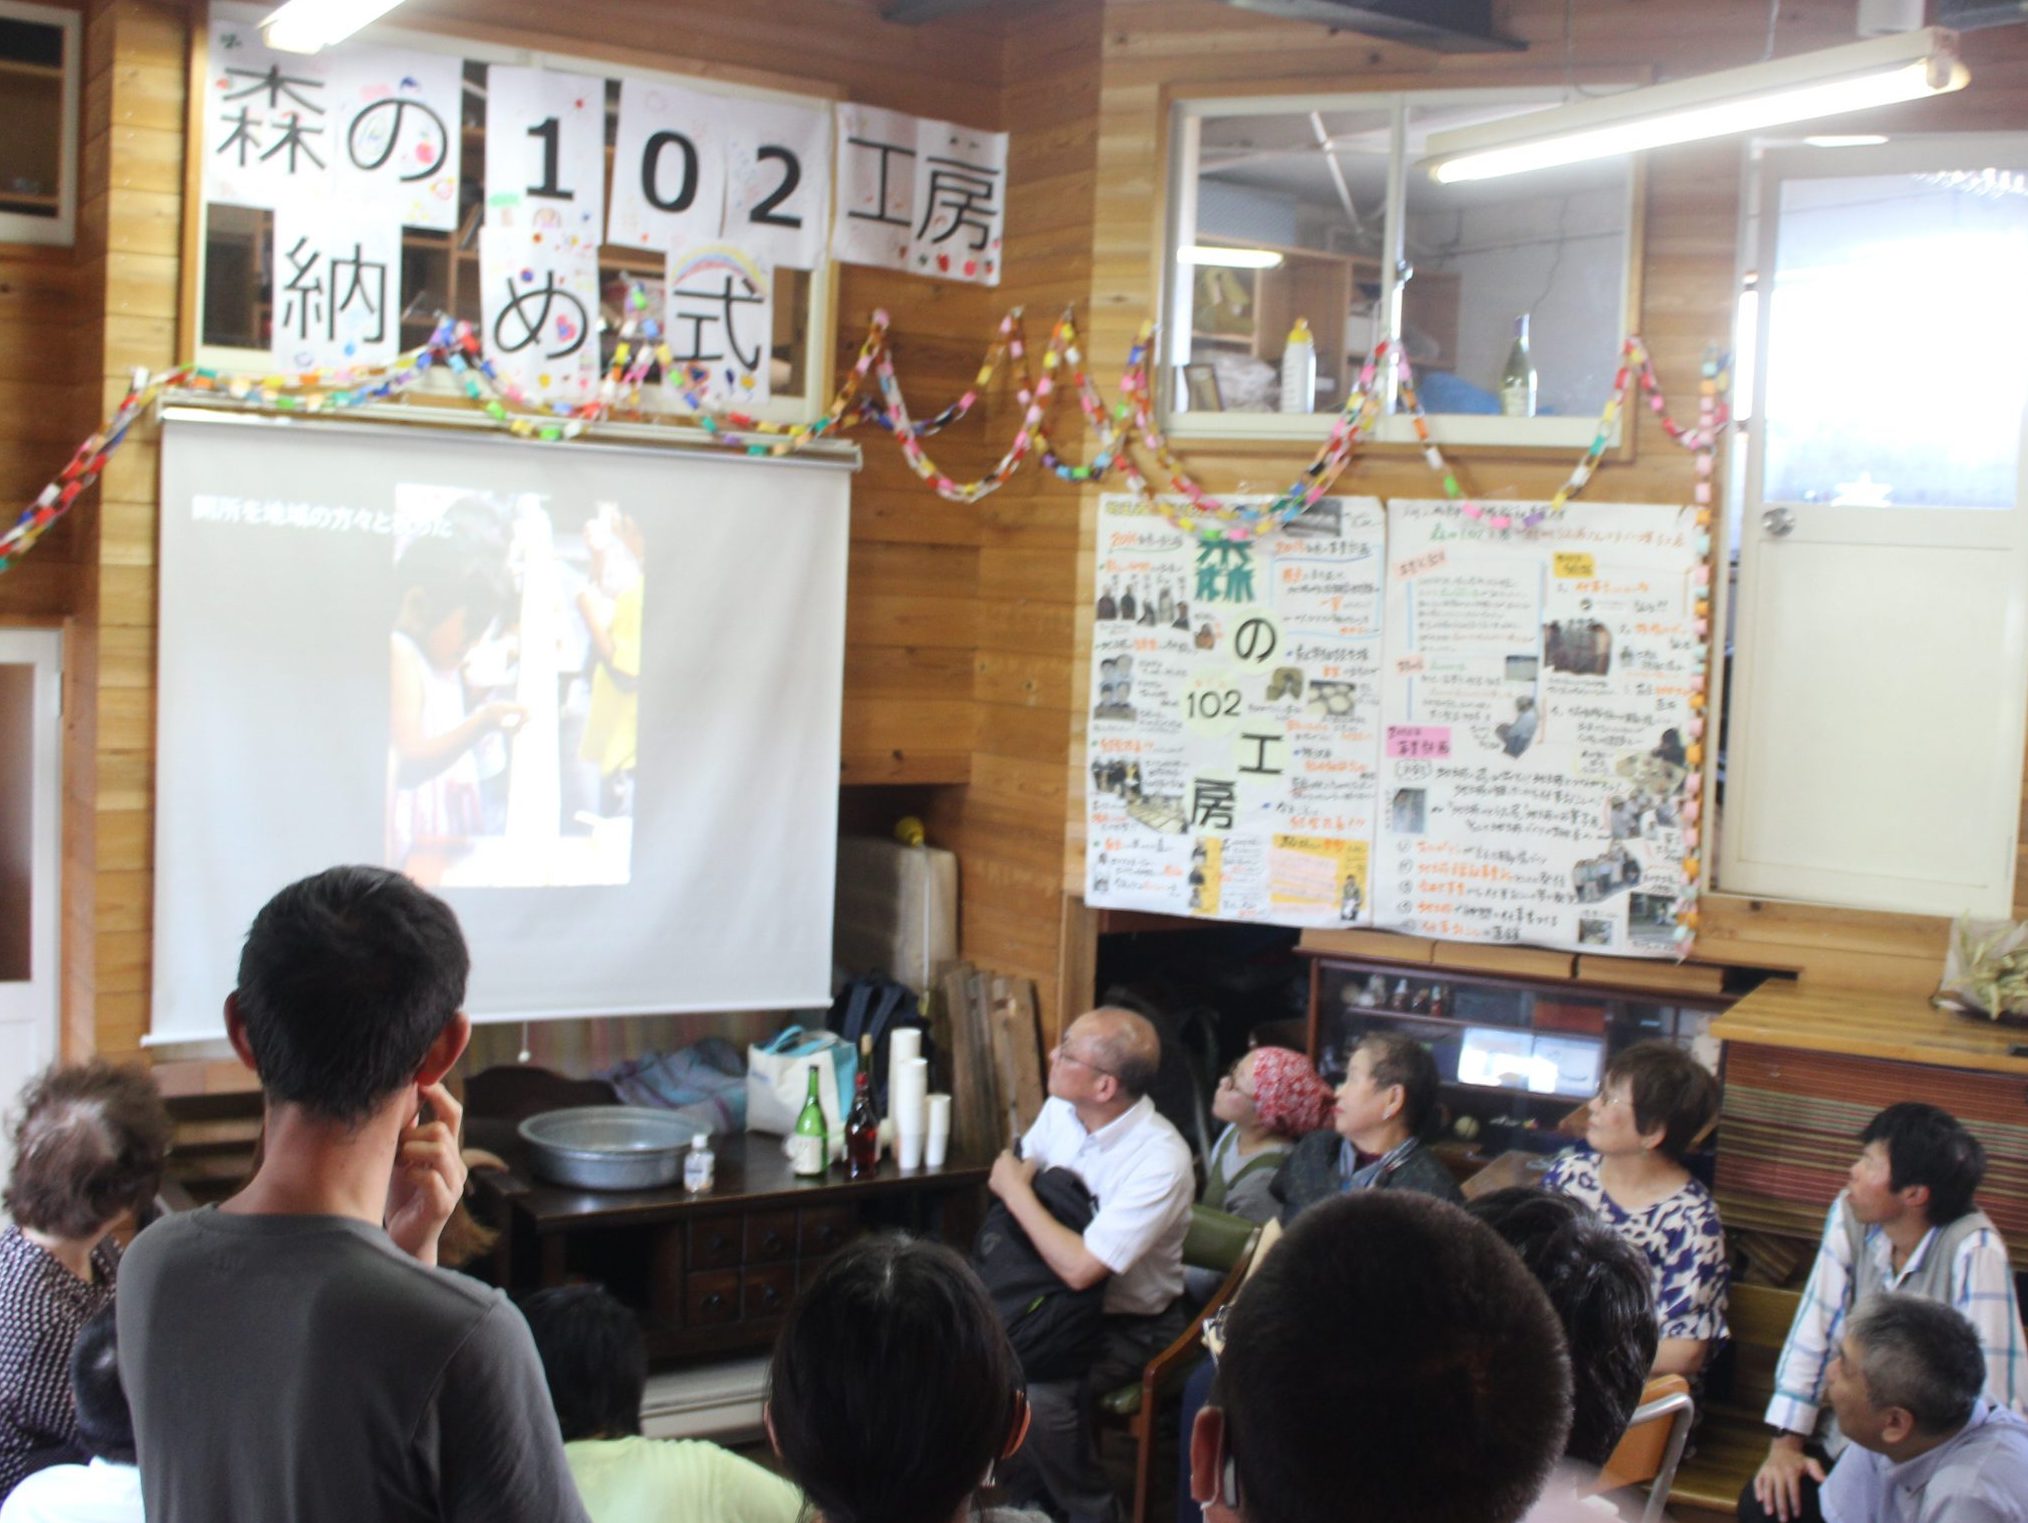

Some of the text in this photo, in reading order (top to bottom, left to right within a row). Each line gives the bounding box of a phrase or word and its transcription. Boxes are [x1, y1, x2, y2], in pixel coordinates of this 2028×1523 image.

[1235, 617, 1277, 663] の
[1187, 689, 1242, 719] 102
[1239, 732, 1284, 775] 工
[1190, 777, 1236, 830] 房
